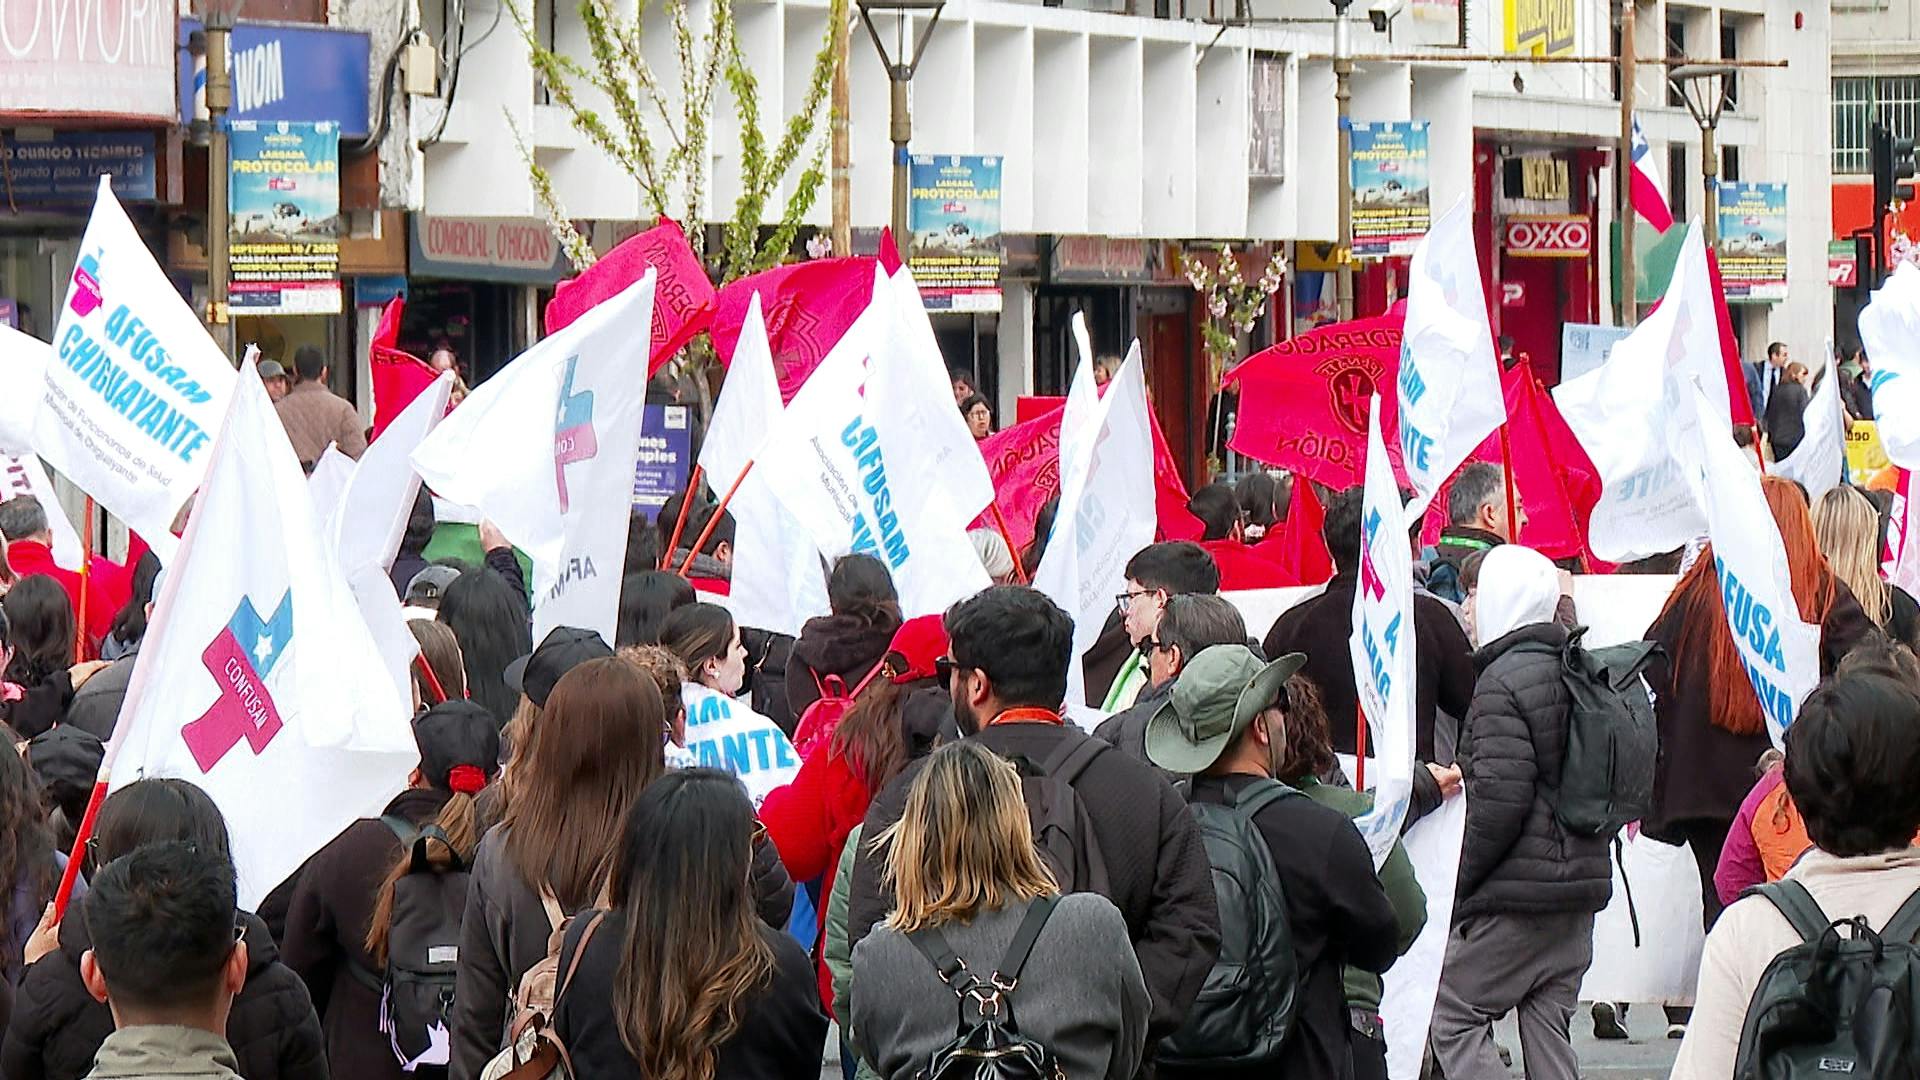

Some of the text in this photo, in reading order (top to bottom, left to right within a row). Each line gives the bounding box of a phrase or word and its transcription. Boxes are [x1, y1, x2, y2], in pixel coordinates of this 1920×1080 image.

[235, 40, 284, 113] WOM
[232, 160, 336, 174] PROTOCOLAR
[1352, 149, 1426, 161] PROTOCOLAR
[912, 188, 999, 200] PROTOCOLAR
[1719, 206, 1786, 217] PROTOCOLAR
[1508, 222, 1588, 249] OXXO
[105, 304, 212, 404] AFUSAM
[58, 323, 212, 464] CHIGUAYANTE
[687, 728, 795, 776] ANTE
